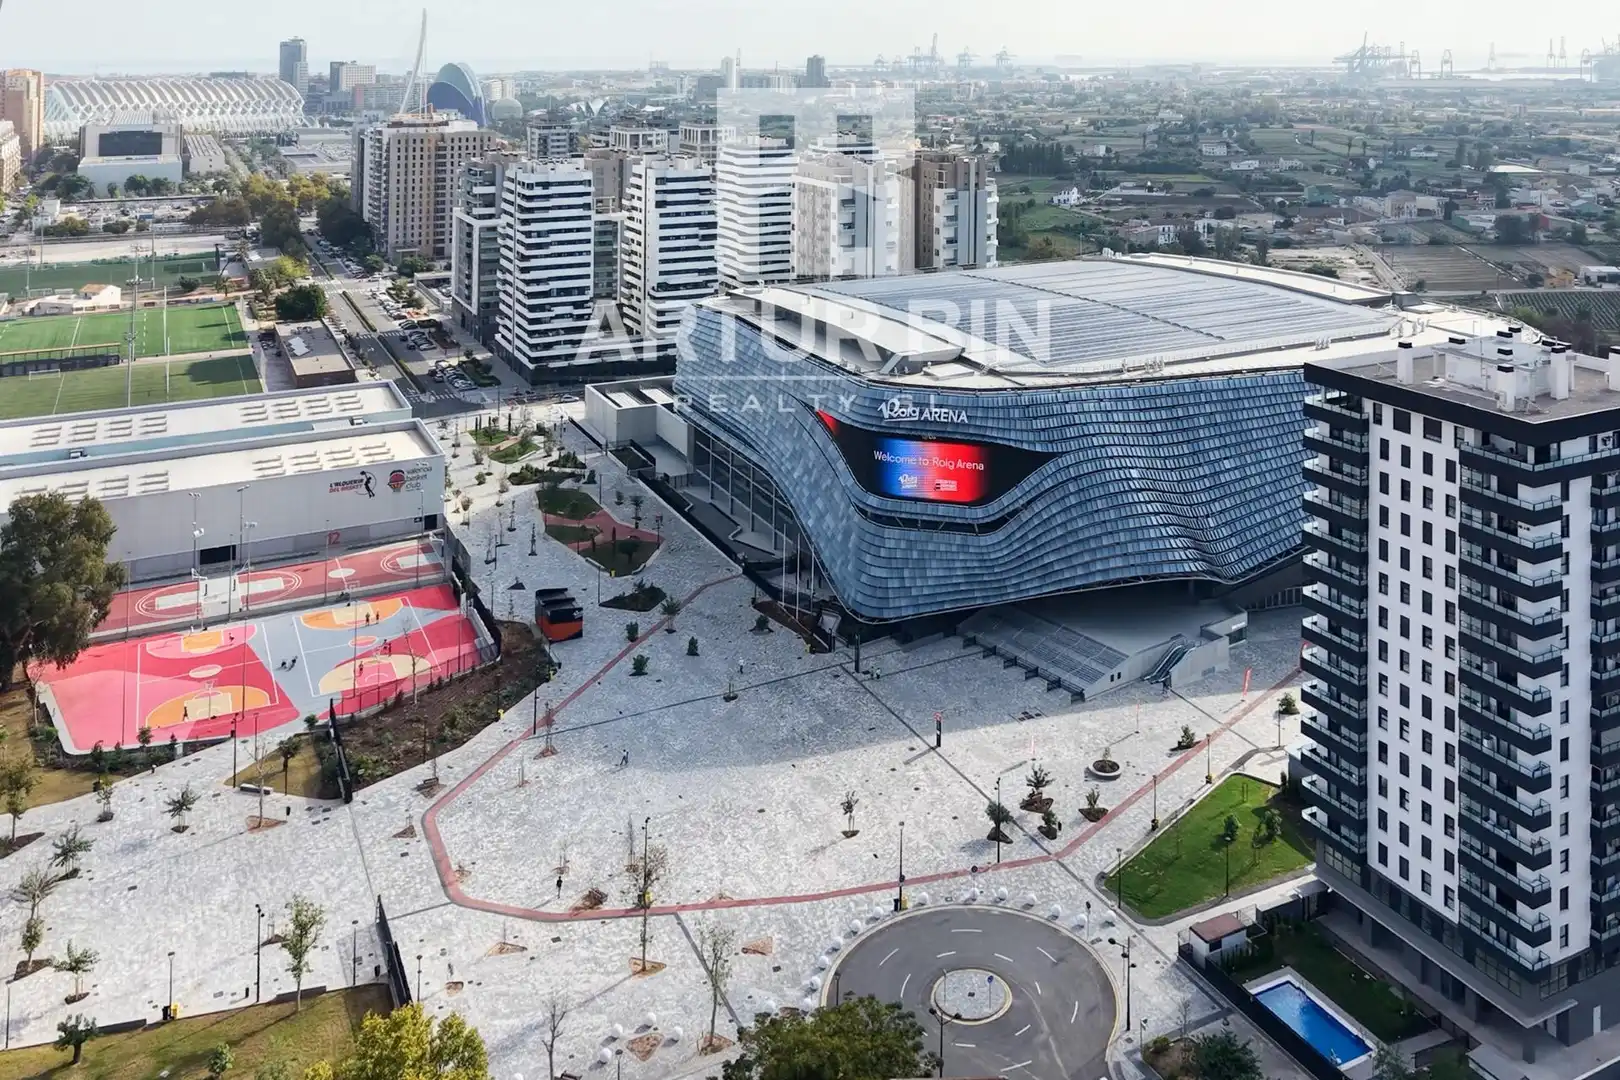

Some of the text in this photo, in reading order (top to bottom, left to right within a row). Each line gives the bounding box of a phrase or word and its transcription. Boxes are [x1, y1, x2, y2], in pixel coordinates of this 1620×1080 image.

[920, 408, 968, 423] ARENA
[873, 450, 984, 471] Welcome to Roig Arena
